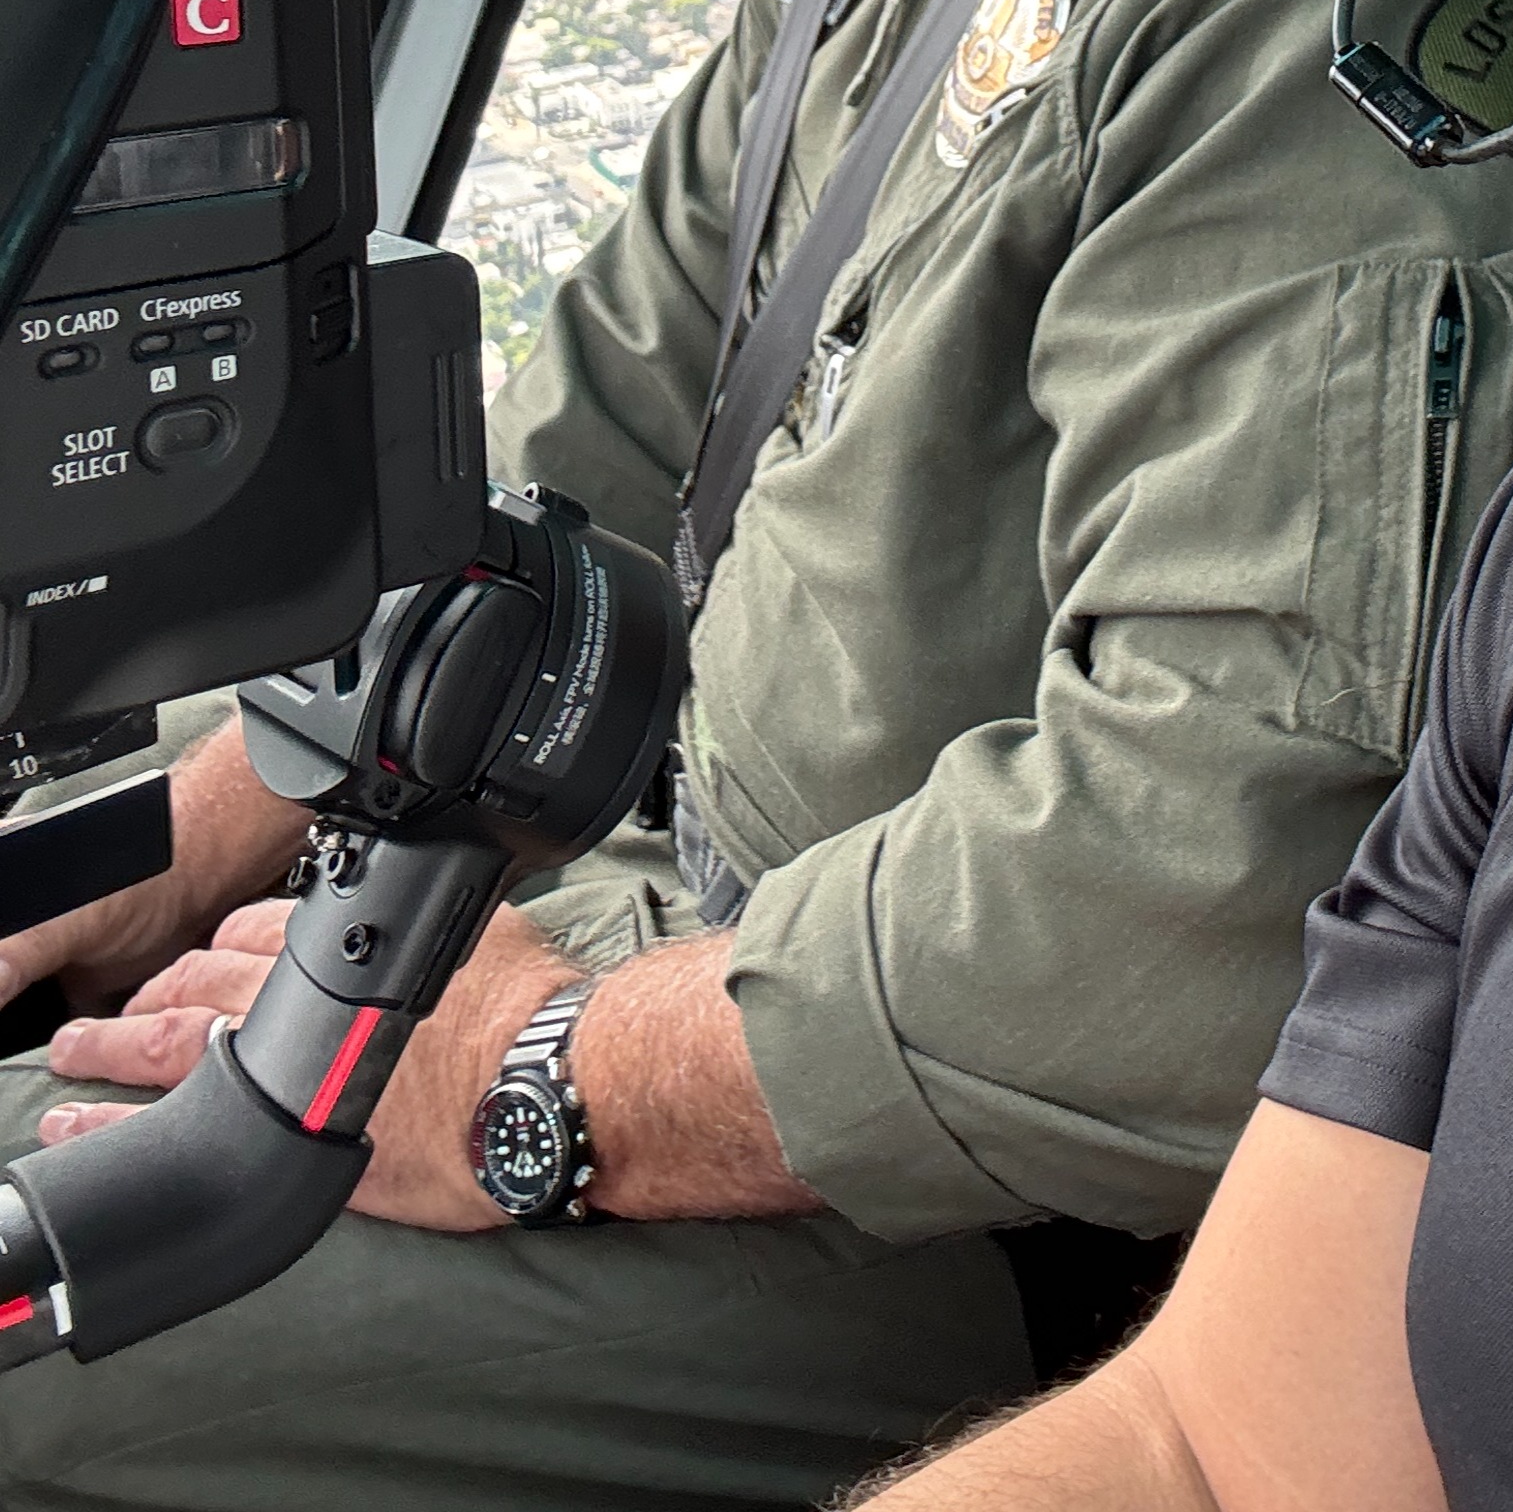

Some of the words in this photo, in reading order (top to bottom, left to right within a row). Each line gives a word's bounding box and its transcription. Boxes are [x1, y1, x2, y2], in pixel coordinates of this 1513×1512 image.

[140, 290, 242, 323] CFexpress
[20, 318, 51, 343] SD
[56, 308, 120, 336] CARD
[154, 369, 173, 390] A
[216, 357, 232, 378] B
[63, 426, 117, 457] SLOT
[51, 451, 130, 488] SELECT
[533, 732, 560, 765] ROLL
[563, 676, 580, 703] FPV
[573, 644, 591, 678] Mode
[9, 755, 39, 780] 10
